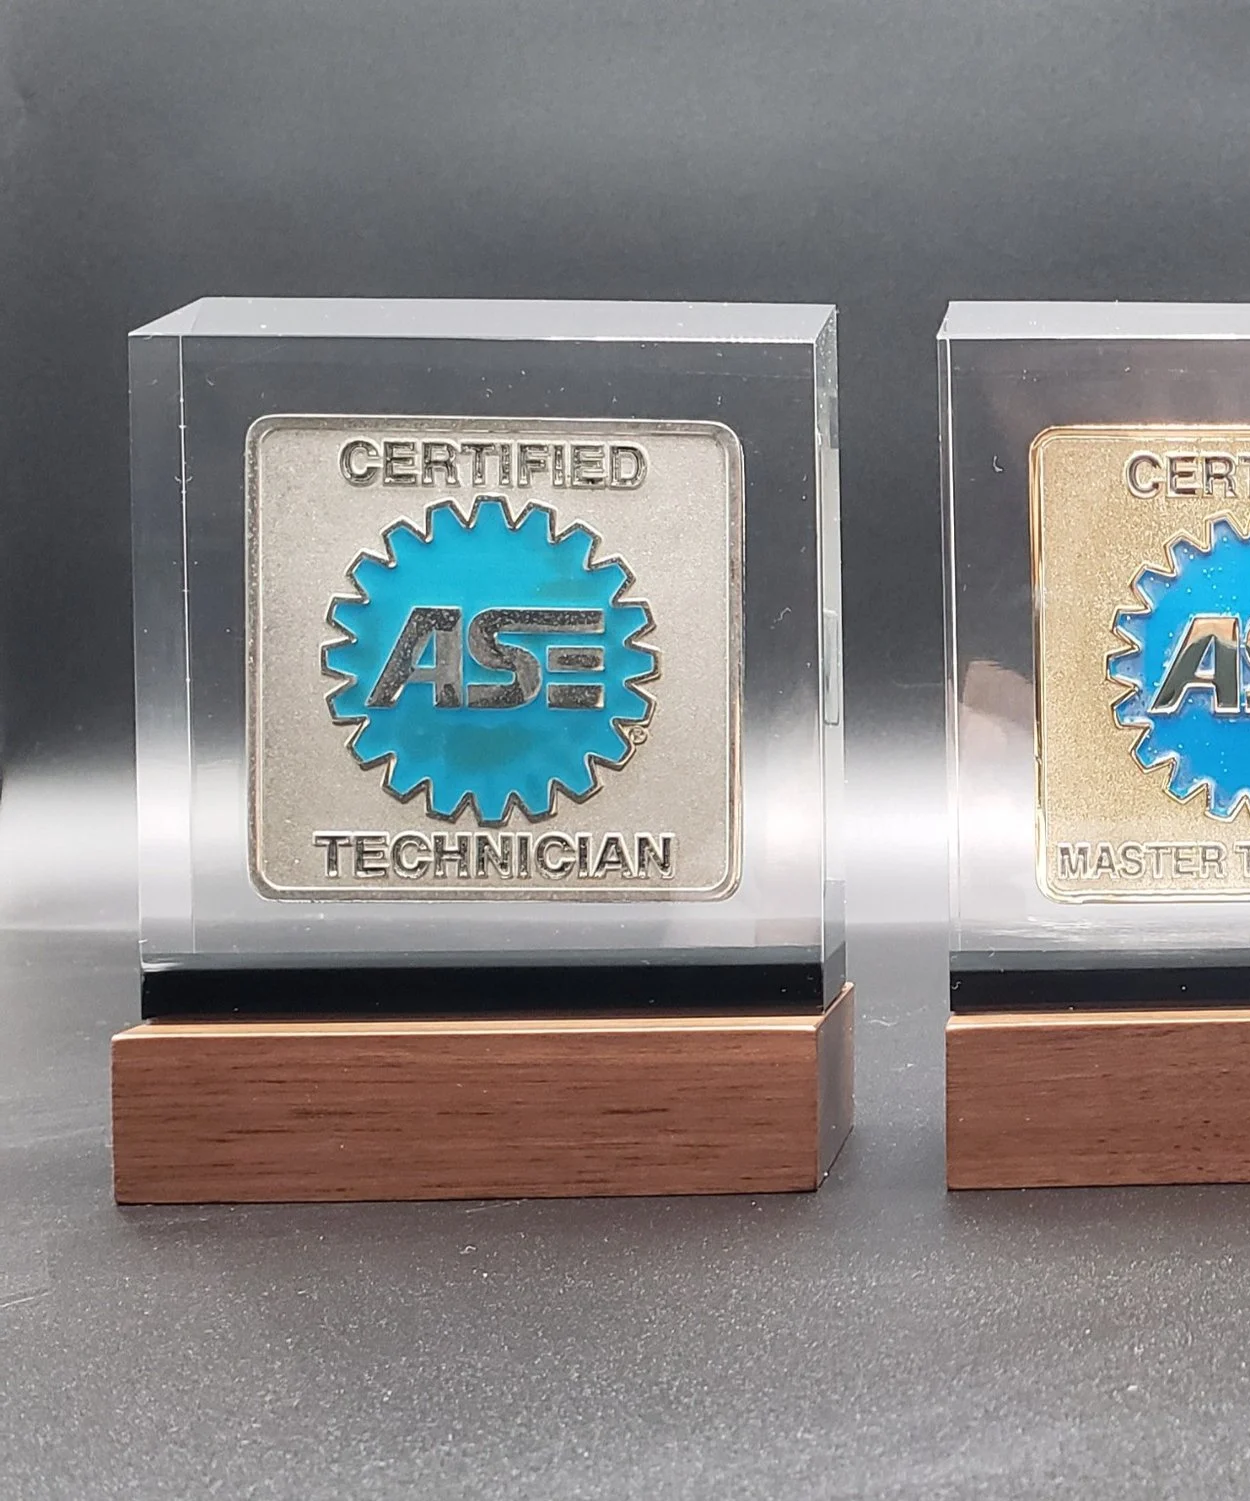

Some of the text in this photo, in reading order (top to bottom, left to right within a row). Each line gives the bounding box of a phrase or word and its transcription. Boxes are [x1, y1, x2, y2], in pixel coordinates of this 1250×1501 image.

[338, 439, 650, 489] CERTIFIED
[365, 606, 605, 710] ASE
[312, 830, 676, 881] TECHNICIAN
[1057, 840, 1228, 881] MASTER
